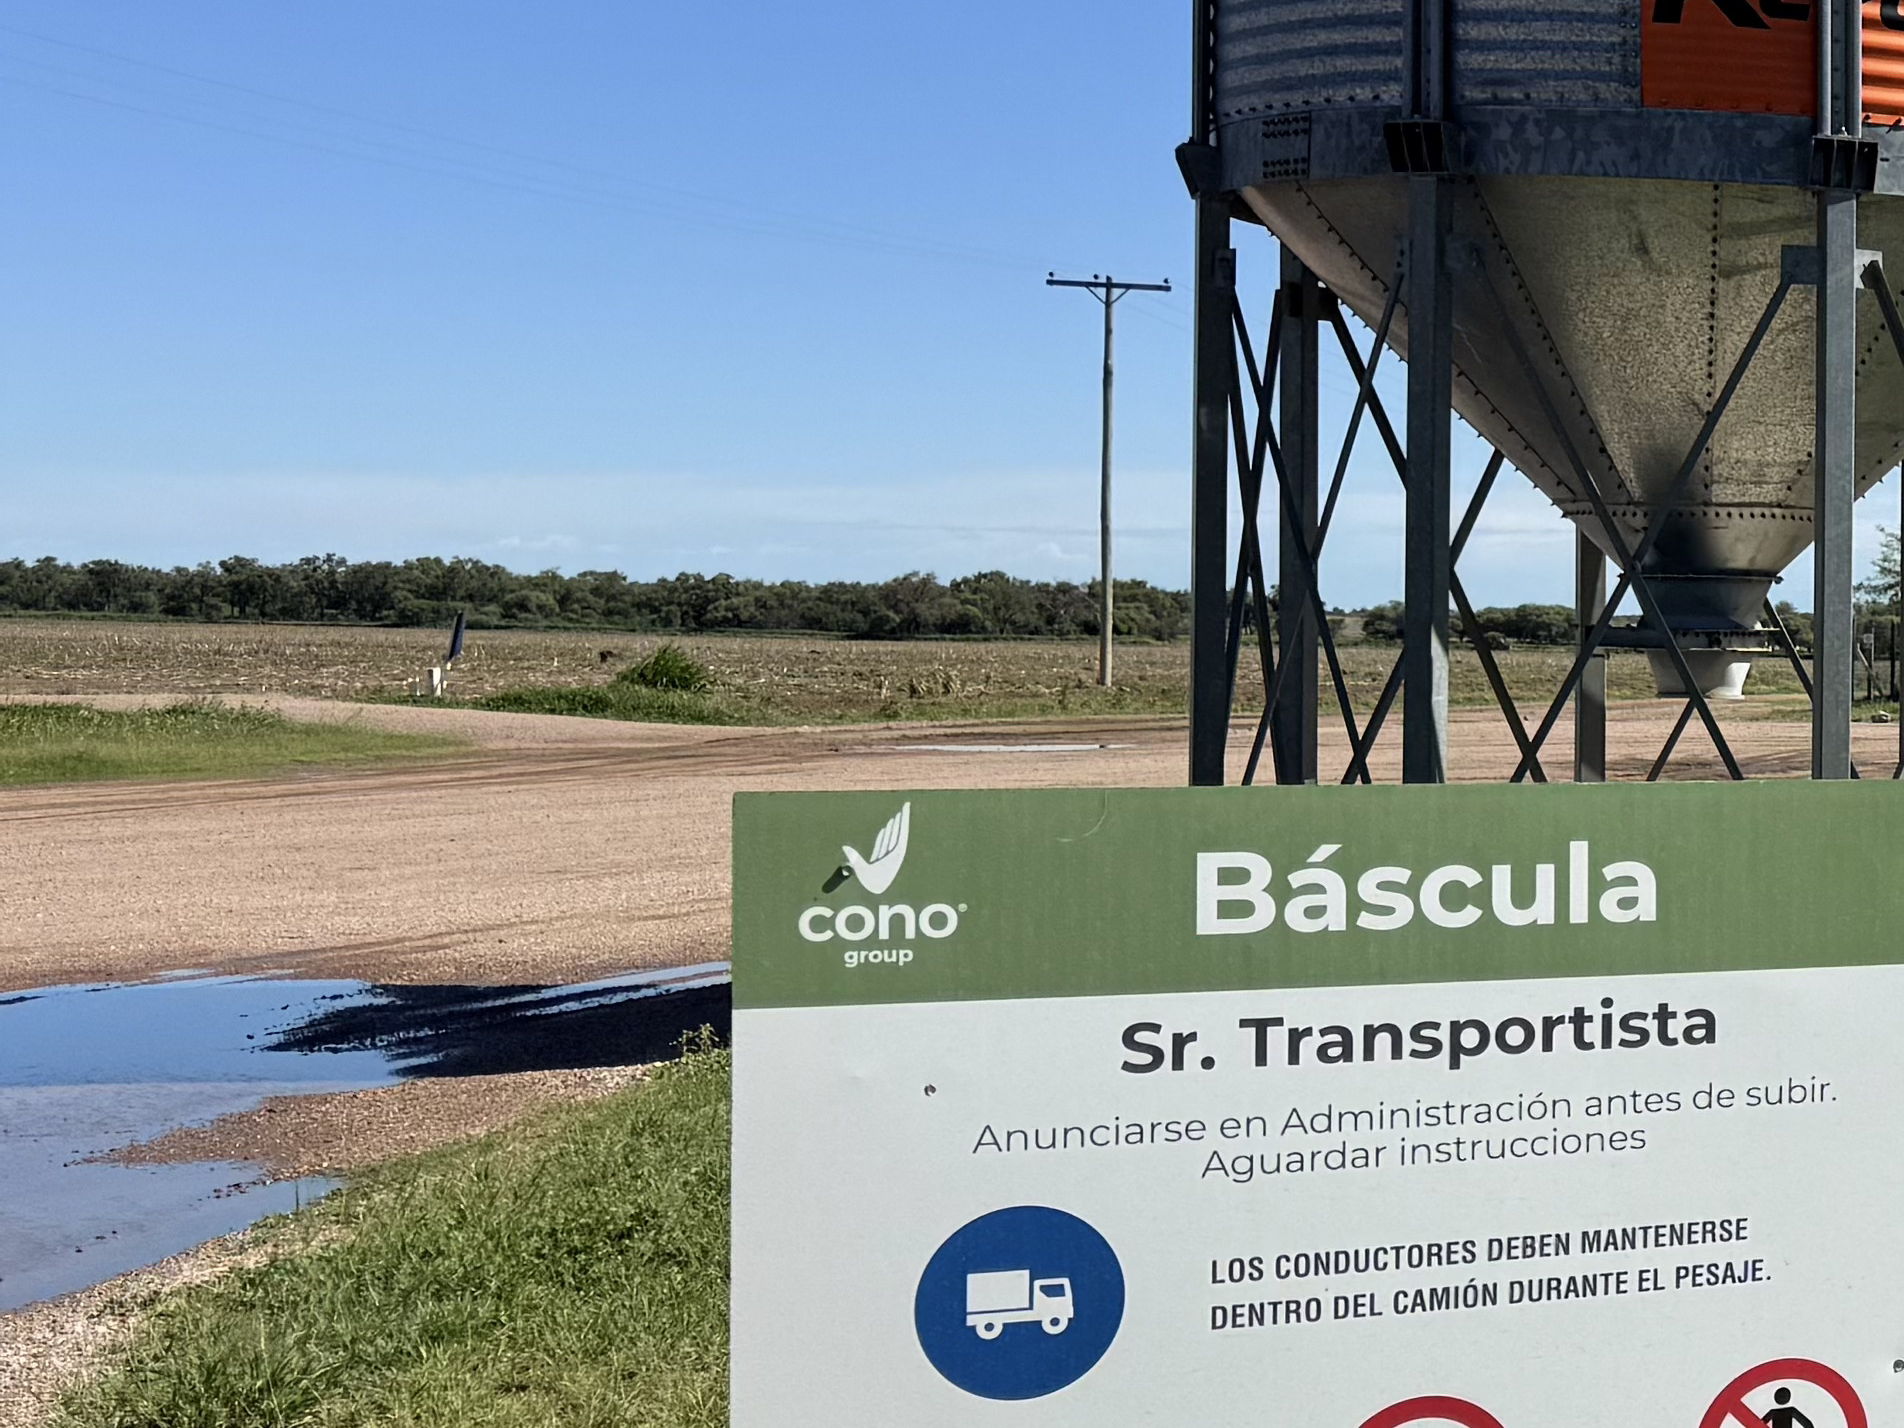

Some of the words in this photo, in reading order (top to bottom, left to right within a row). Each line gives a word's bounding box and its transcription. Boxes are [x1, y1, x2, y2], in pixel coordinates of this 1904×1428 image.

[1197, 841, 1656, 935] Báscula
[844, 950, 913, 967] group
[1121, 1022, 1215, 1073] Sr.
[1239, 997, 1715, 1070] Transportista
[973, 1116, 1206, 1153] Anunciarse
[1220, 1117, 1266, 1138] en
[1281, 1092, 1570, 1135] Administración
[1585, 1090, 1681, 1116] antes
[1693, 1083, 1735, 1109] de
[1746, 1076, 1836, 1106] subir.
[1202, 1141, 1386, 1183] Aguardar
[1401, 1128, 1646, 1165] instrucciones
[1212, 1257, 1263, 1284] LOS
[1276, 1240, 1476, 1279] CONDUCTORES
[1488, 1233, 1569, 1261] DEBEN
[1582, 1218, 1748, 1253] MANTENERSE
[1212, 1298, 1321, 1330] DENTRO
[1334, 1293, 1382, 1319] DEL
[1394, 1278, 1497, 1314] CAMIÓN
[1509, 1271, 1628, 1304] DURANTE
[1638, 1268, 1665, 1292] EL
[1676, 1259, 1771, 1289] PESAJE.
